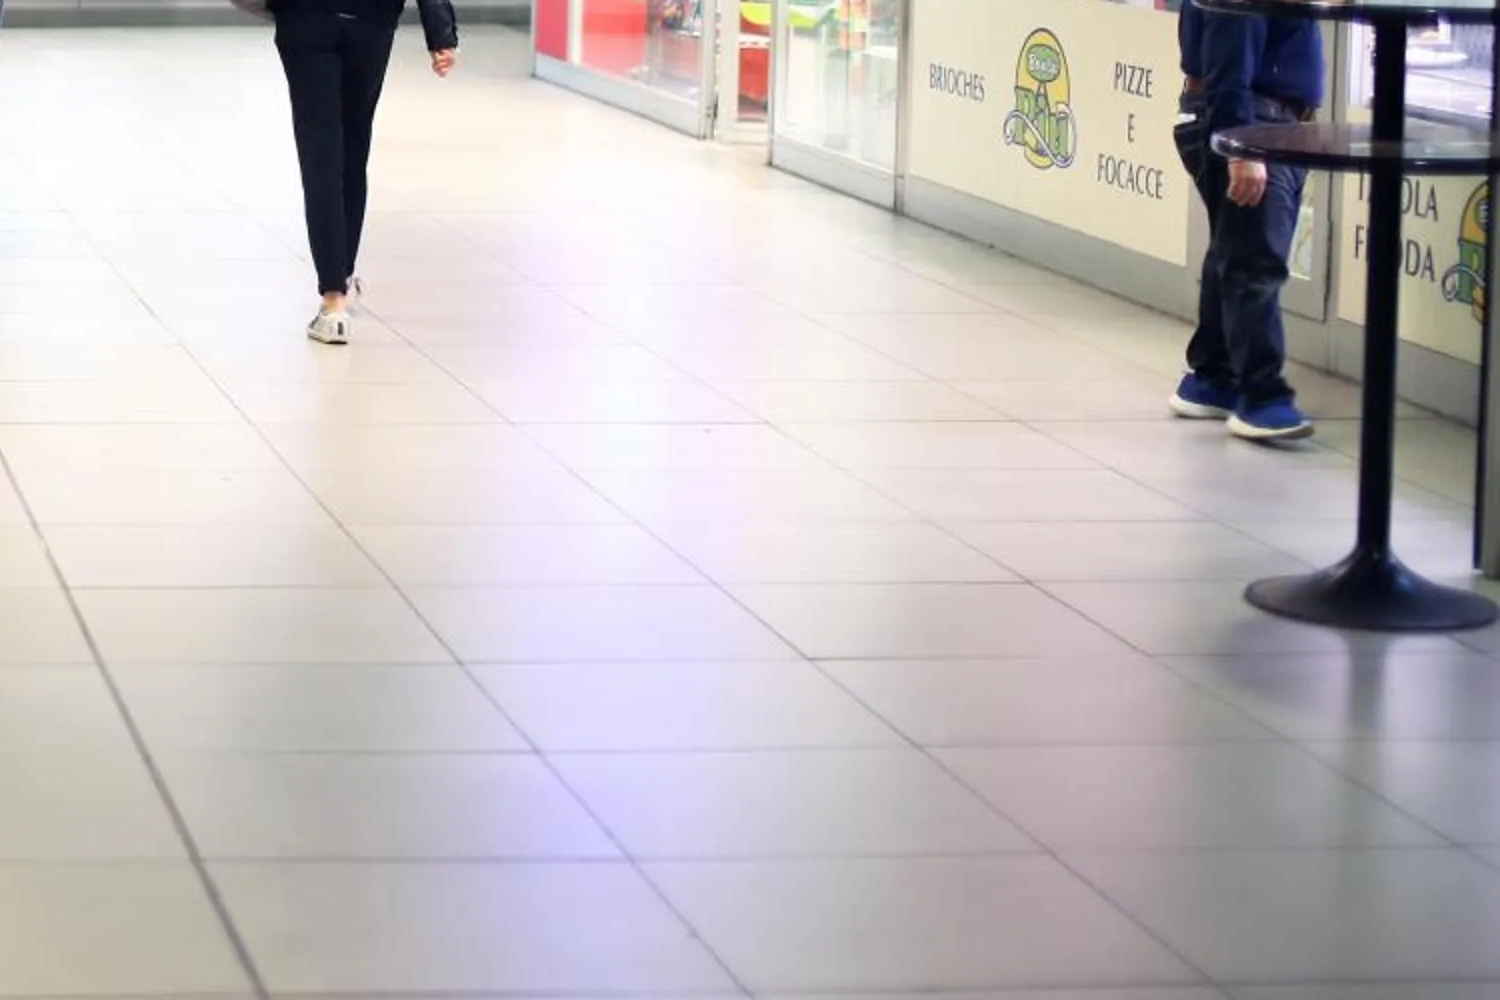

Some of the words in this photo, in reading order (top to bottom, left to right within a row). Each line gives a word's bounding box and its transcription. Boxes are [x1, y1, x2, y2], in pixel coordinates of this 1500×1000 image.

[929, 63, 985, 102] BRIOCHES
[1113, 61, 1153, 98] PIZZE
[1127, 112, 1135, 143] E
[1097, 153, 1164, 200] FOCACCE
